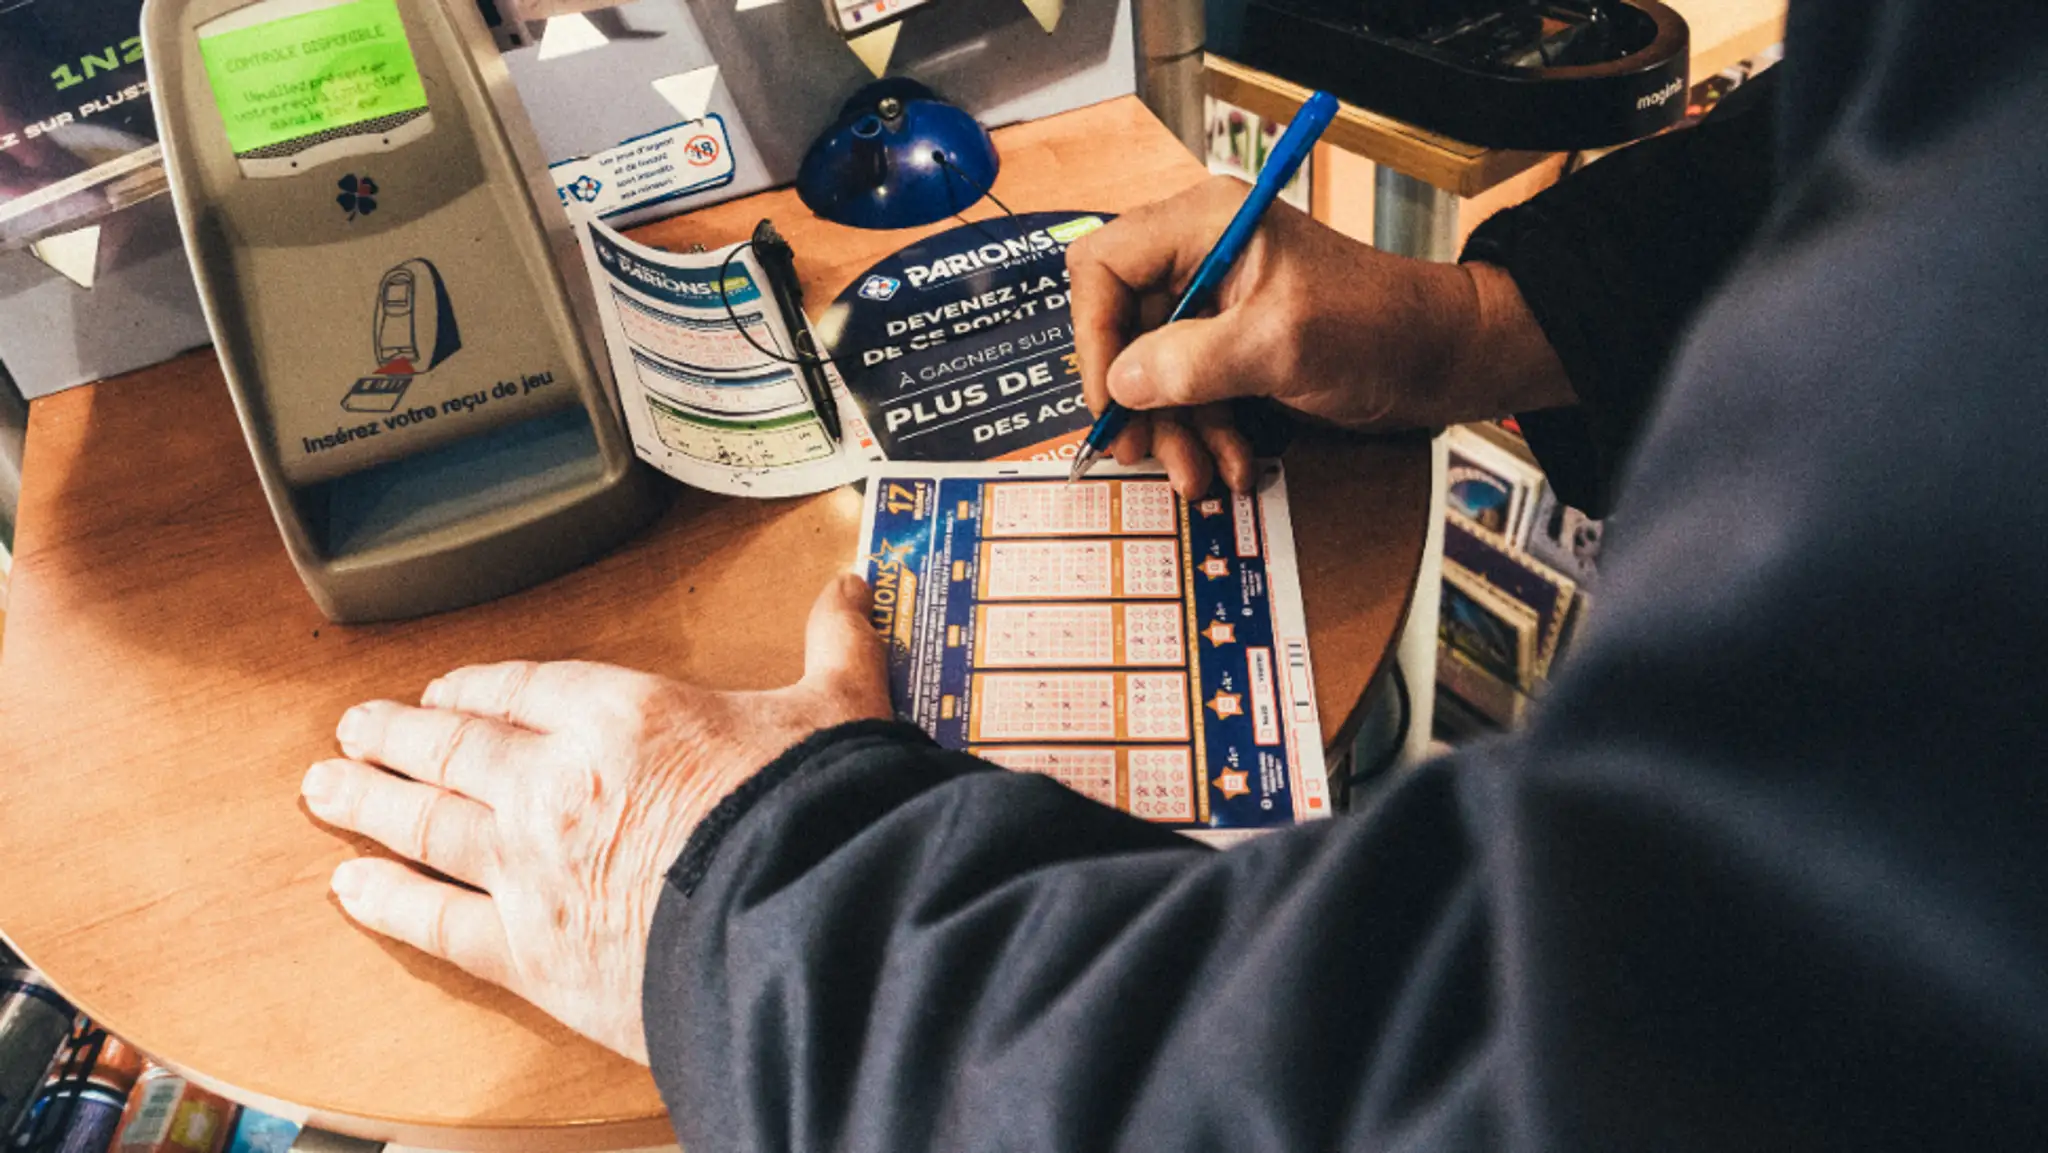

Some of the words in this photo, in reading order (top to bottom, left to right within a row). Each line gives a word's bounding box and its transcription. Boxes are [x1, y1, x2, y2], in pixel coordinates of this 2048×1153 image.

[51, 36, 144, 91] 1N2
[0, 132, 20, 149] Z
[24, 111, 75, 139] SUR
[904, 229, 1054, 288] PARIONS
[863, 345, 904, 367] DE
[909, 329, 947, 351] CE
[952, 299, 1038, 335] POINT
[886, 286, 1017, 337] DEVENEZ
[919, 341, 1014, 381] GAGNER
[1018, 326, 1064, 350] SUR
[302, 420, 381, 453] Insérez
[384, 404, 438, 430] votre
[442, 390, 489, 416] reçu
[491, 380, 518, 400] de
[522, 371, 554, 396] jeu
[885, 383, 989, 433] PLUS
[998, 361, 1054, 397] DE
[972, 412, 1031, 444] DES
[887, 482, 915, 516] 17
